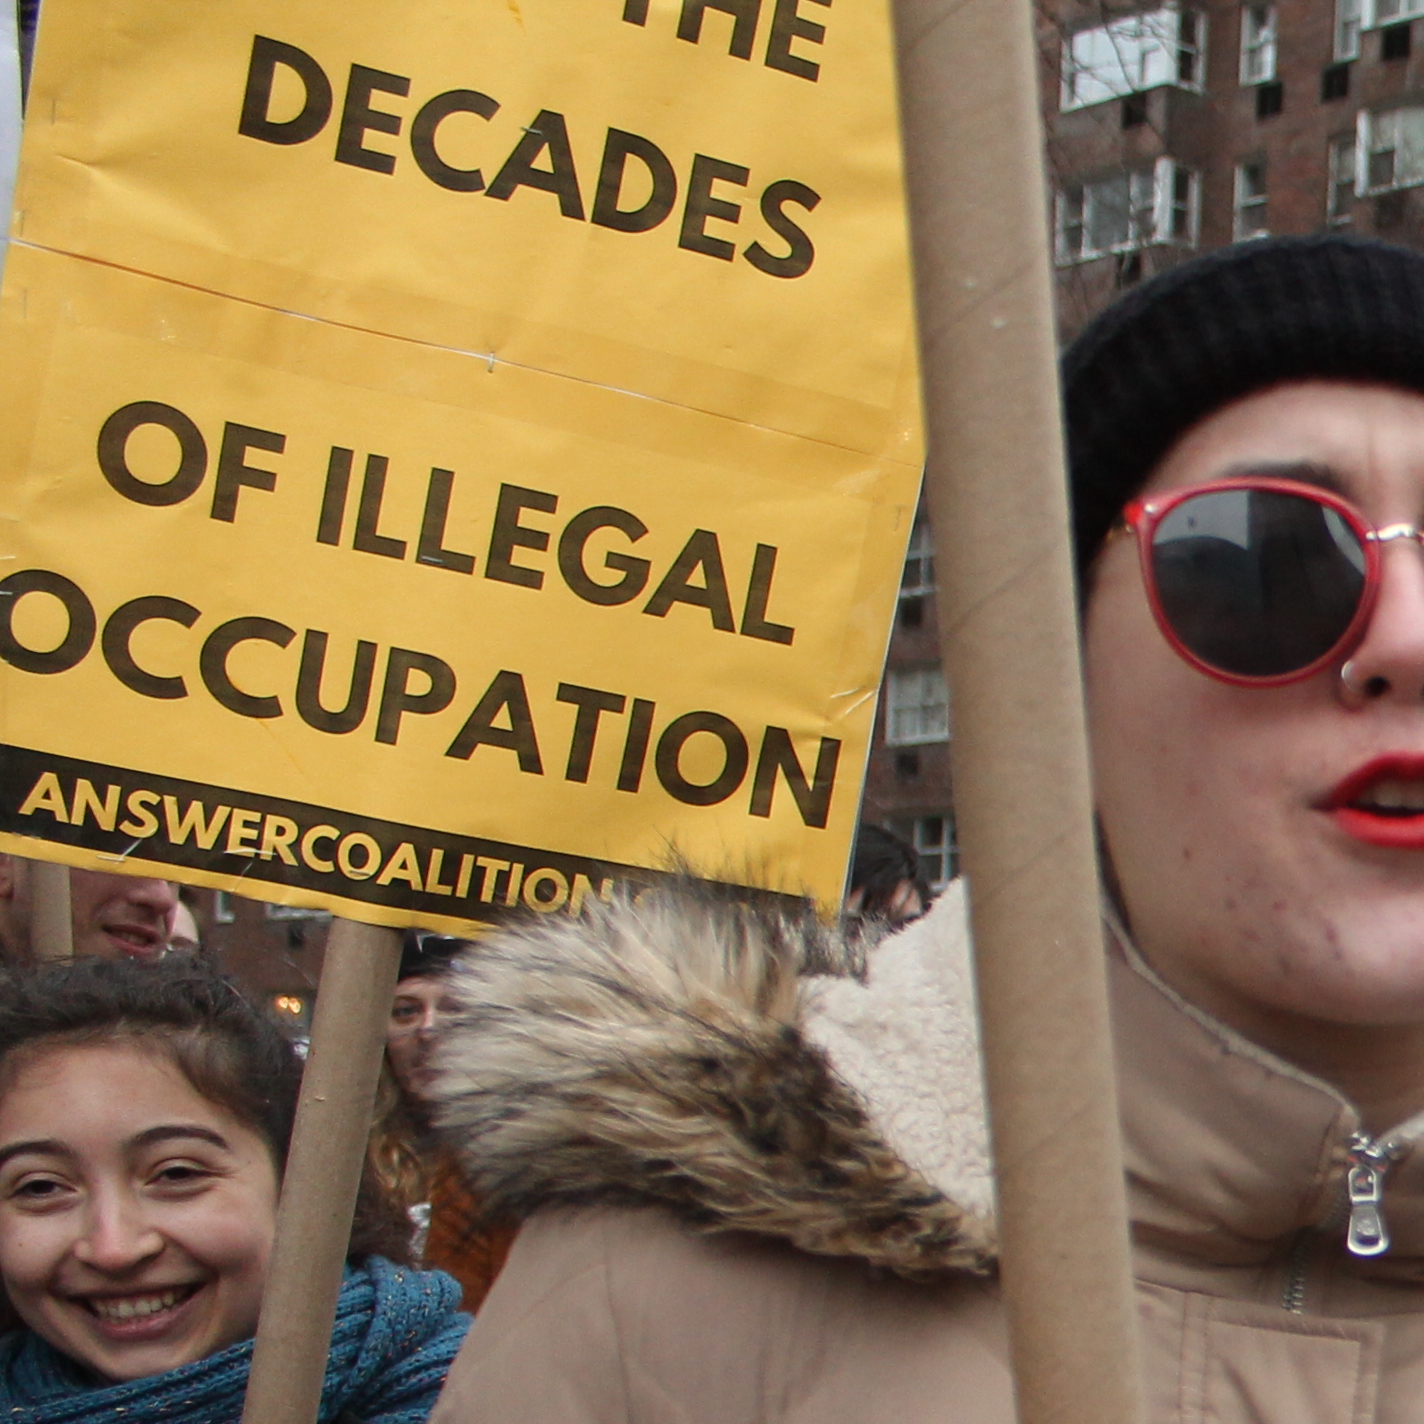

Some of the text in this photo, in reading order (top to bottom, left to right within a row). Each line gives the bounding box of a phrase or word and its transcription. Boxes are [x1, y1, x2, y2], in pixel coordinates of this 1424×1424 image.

[238, 34, 823, 280] DECADES
[622, 0, 833, 83] HE
[96, 400, 798, 646] OF ILLEGAL
[0, 569, 844, 830] OCCUPATION
[18, 771, 615, 917] ANSWERCOALITION
